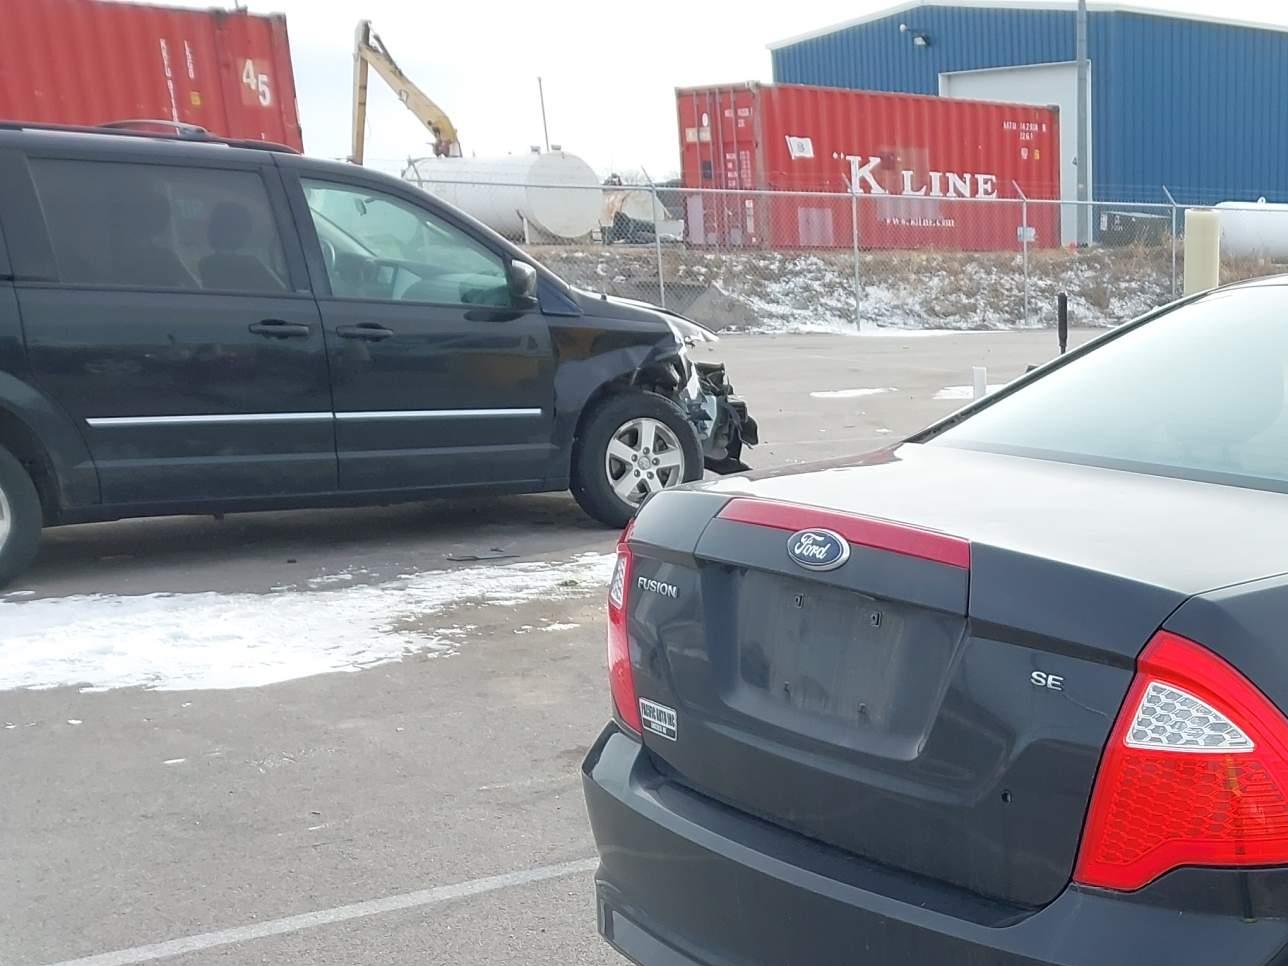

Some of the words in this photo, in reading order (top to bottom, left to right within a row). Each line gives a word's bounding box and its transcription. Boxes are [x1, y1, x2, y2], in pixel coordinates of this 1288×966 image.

[242, 58, 272, 107] 45
[901, 170, 998, 199] LINE
[794, 533, 829, 559] Ford
[638, 576, 678, 598] FUSION
[1030, 671, 1065, 691] SE
